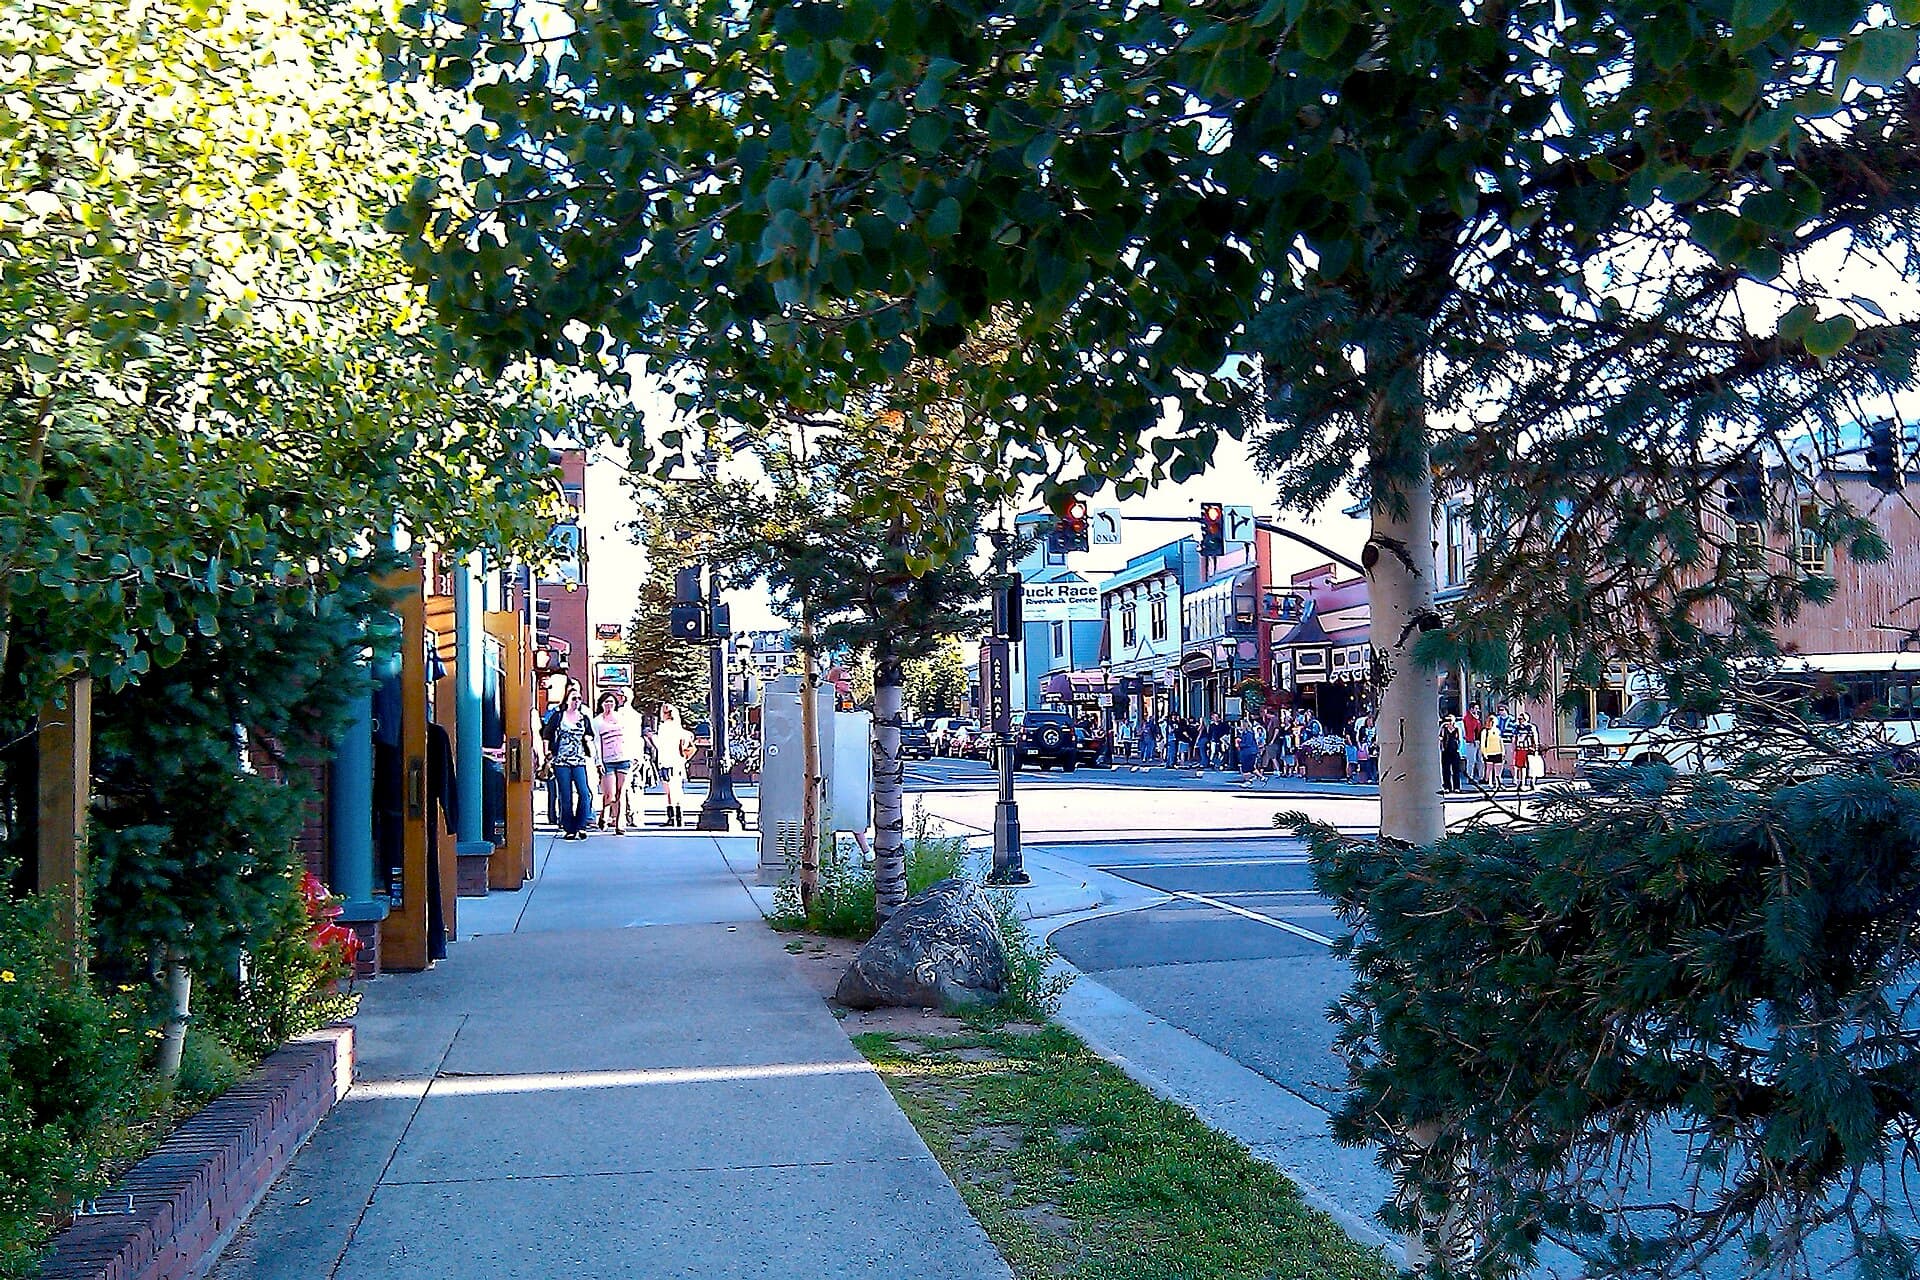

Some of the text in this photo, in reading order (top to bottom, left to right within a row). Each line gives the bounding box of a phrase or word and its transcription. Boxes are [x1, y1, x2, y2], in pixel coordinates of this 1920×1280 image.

[1096, 534, 1117, 543] ONLY
[1058, 585, 1098, 597] Race
[993, 658, 1002, 719] AREA MAP
